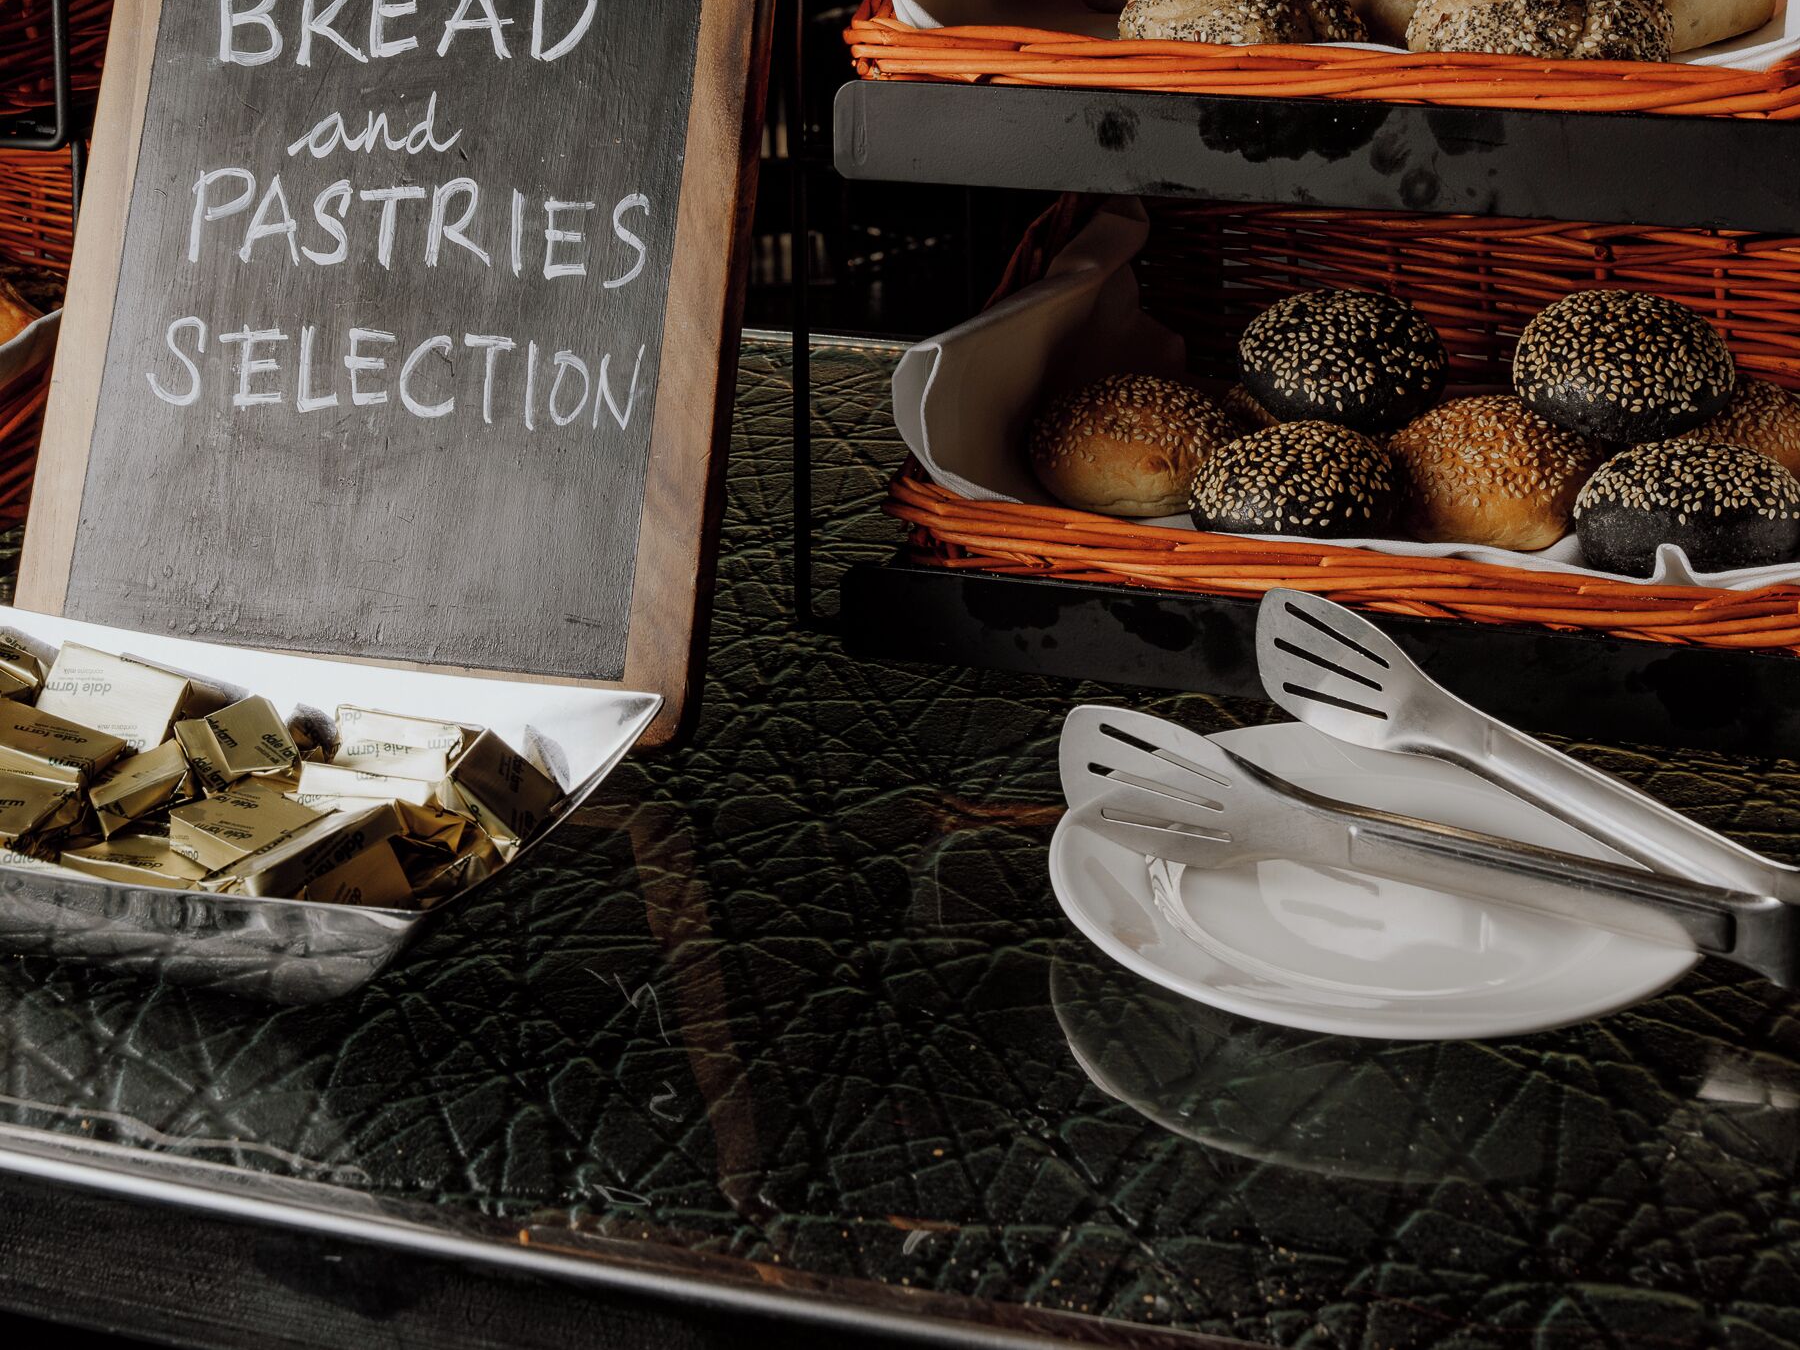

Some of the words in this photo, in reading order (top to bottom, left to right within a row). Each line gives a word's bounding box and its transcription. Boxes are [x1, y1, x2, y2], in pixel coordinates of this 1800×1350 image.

[287, 91, 463, 159] and
[187, 167, 651, 289] PASTRIES
[145, 315, 646, 431] SELECTION
[46, 681, 79, 697] farm
[81, 681, 112, 697] dale
[13, 723, 52, 738] farm
[53, 732, 88, 745] dale
[217, 727, 238, 749] farm
[262, 733, 283, 749] dale
[346, 742, 381, 758] farm
[191, 756, 213, 773] dale
[231, 798, 259, 810] dale
[223, 830, 253, 841] dale
[335, 831, 364, 862] dale
